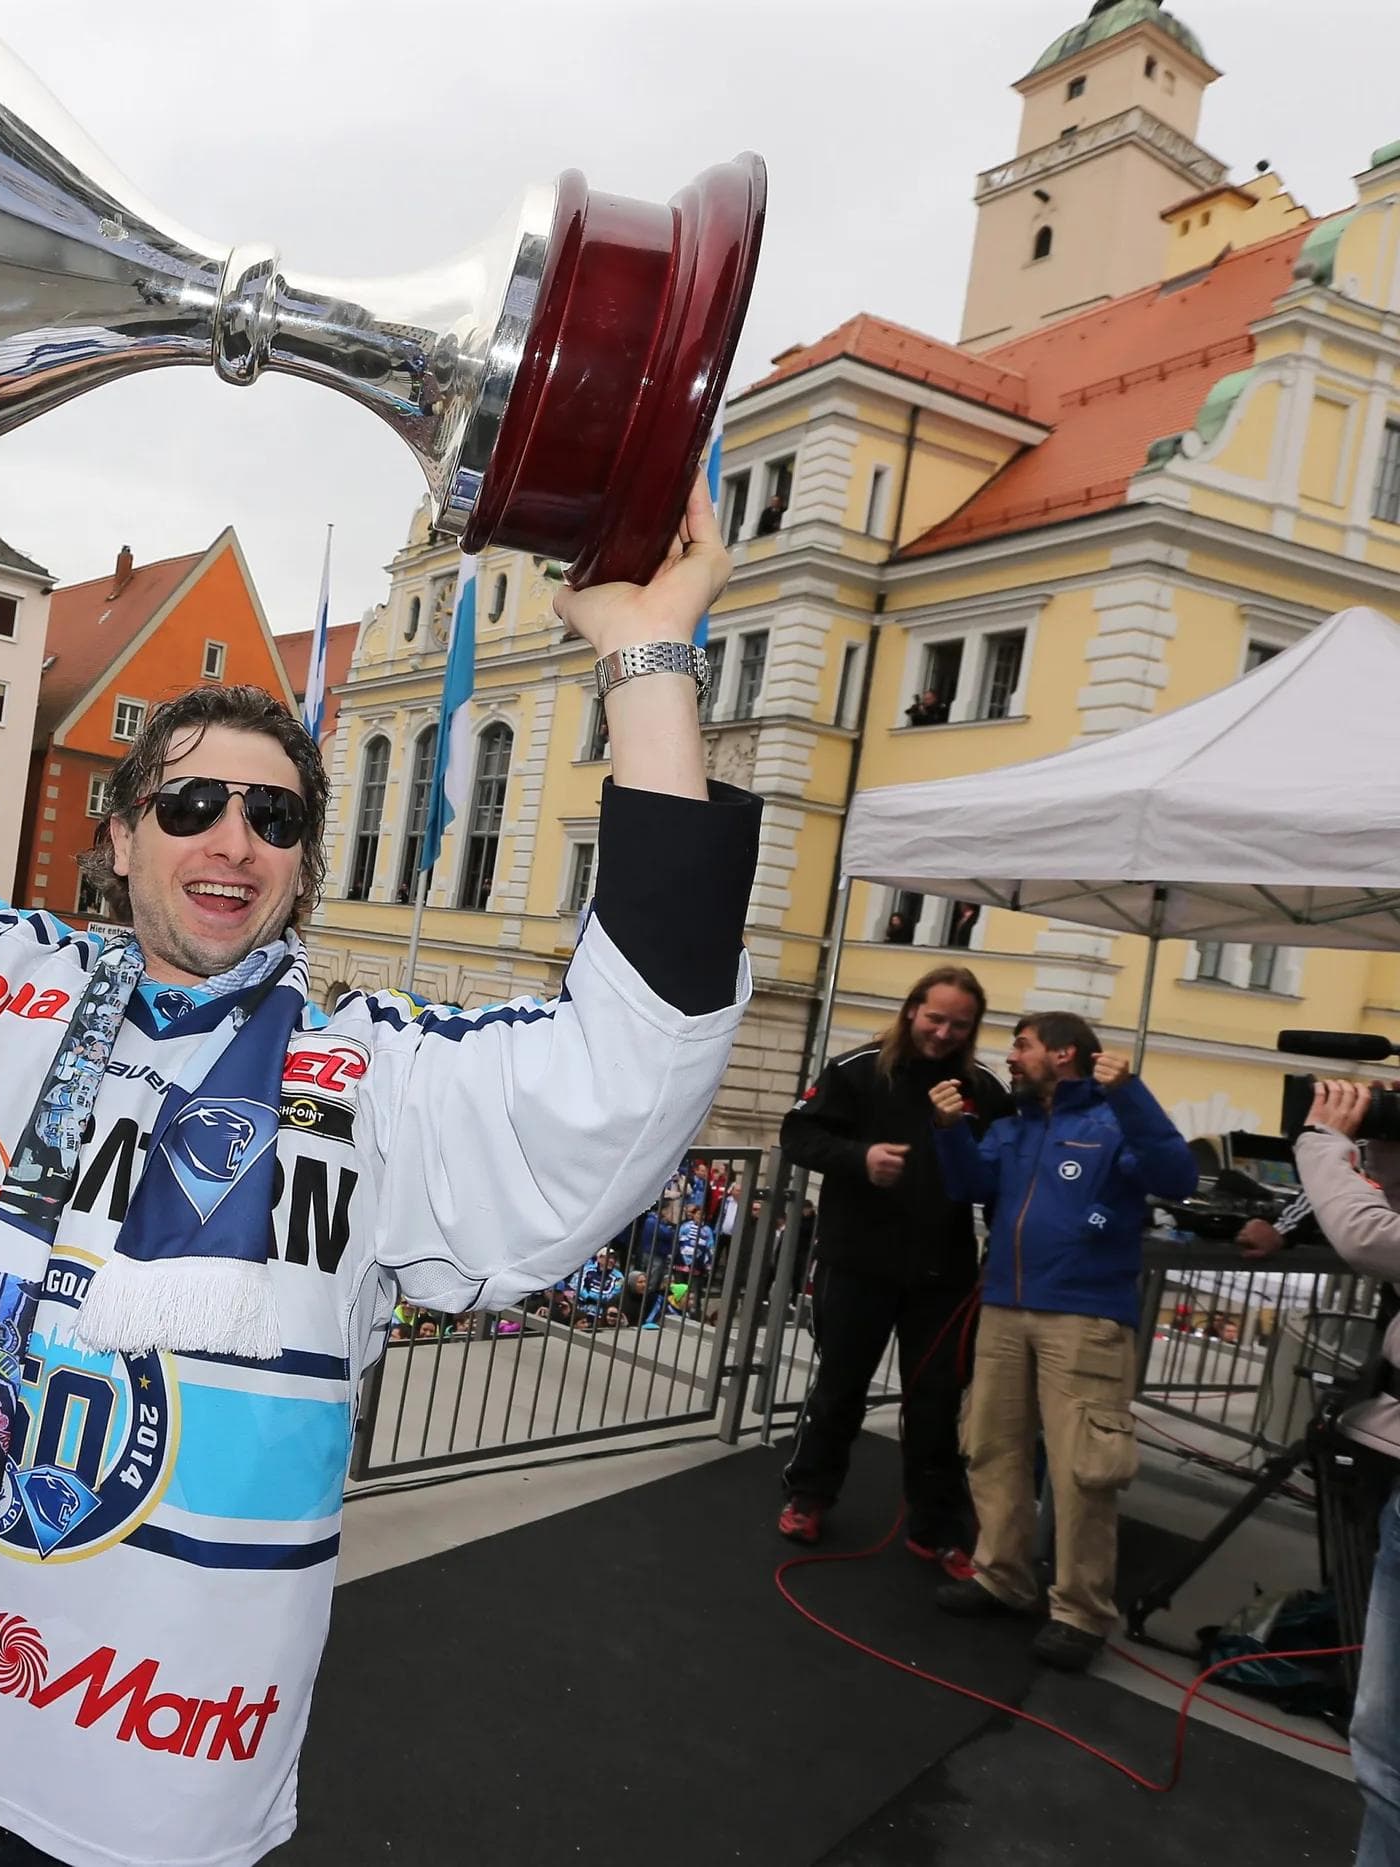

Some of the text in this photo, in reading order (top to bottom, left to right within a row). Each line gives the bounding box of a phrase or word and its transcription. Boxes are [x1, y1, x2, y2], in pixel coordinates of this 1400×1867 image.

[282, 1048, 366, 1092] EL
[280, 1105, 324, 1122] HPOINT
[119, 1403, 159, 1490] 2014
[28, 1646, 280, 1761] Markt
